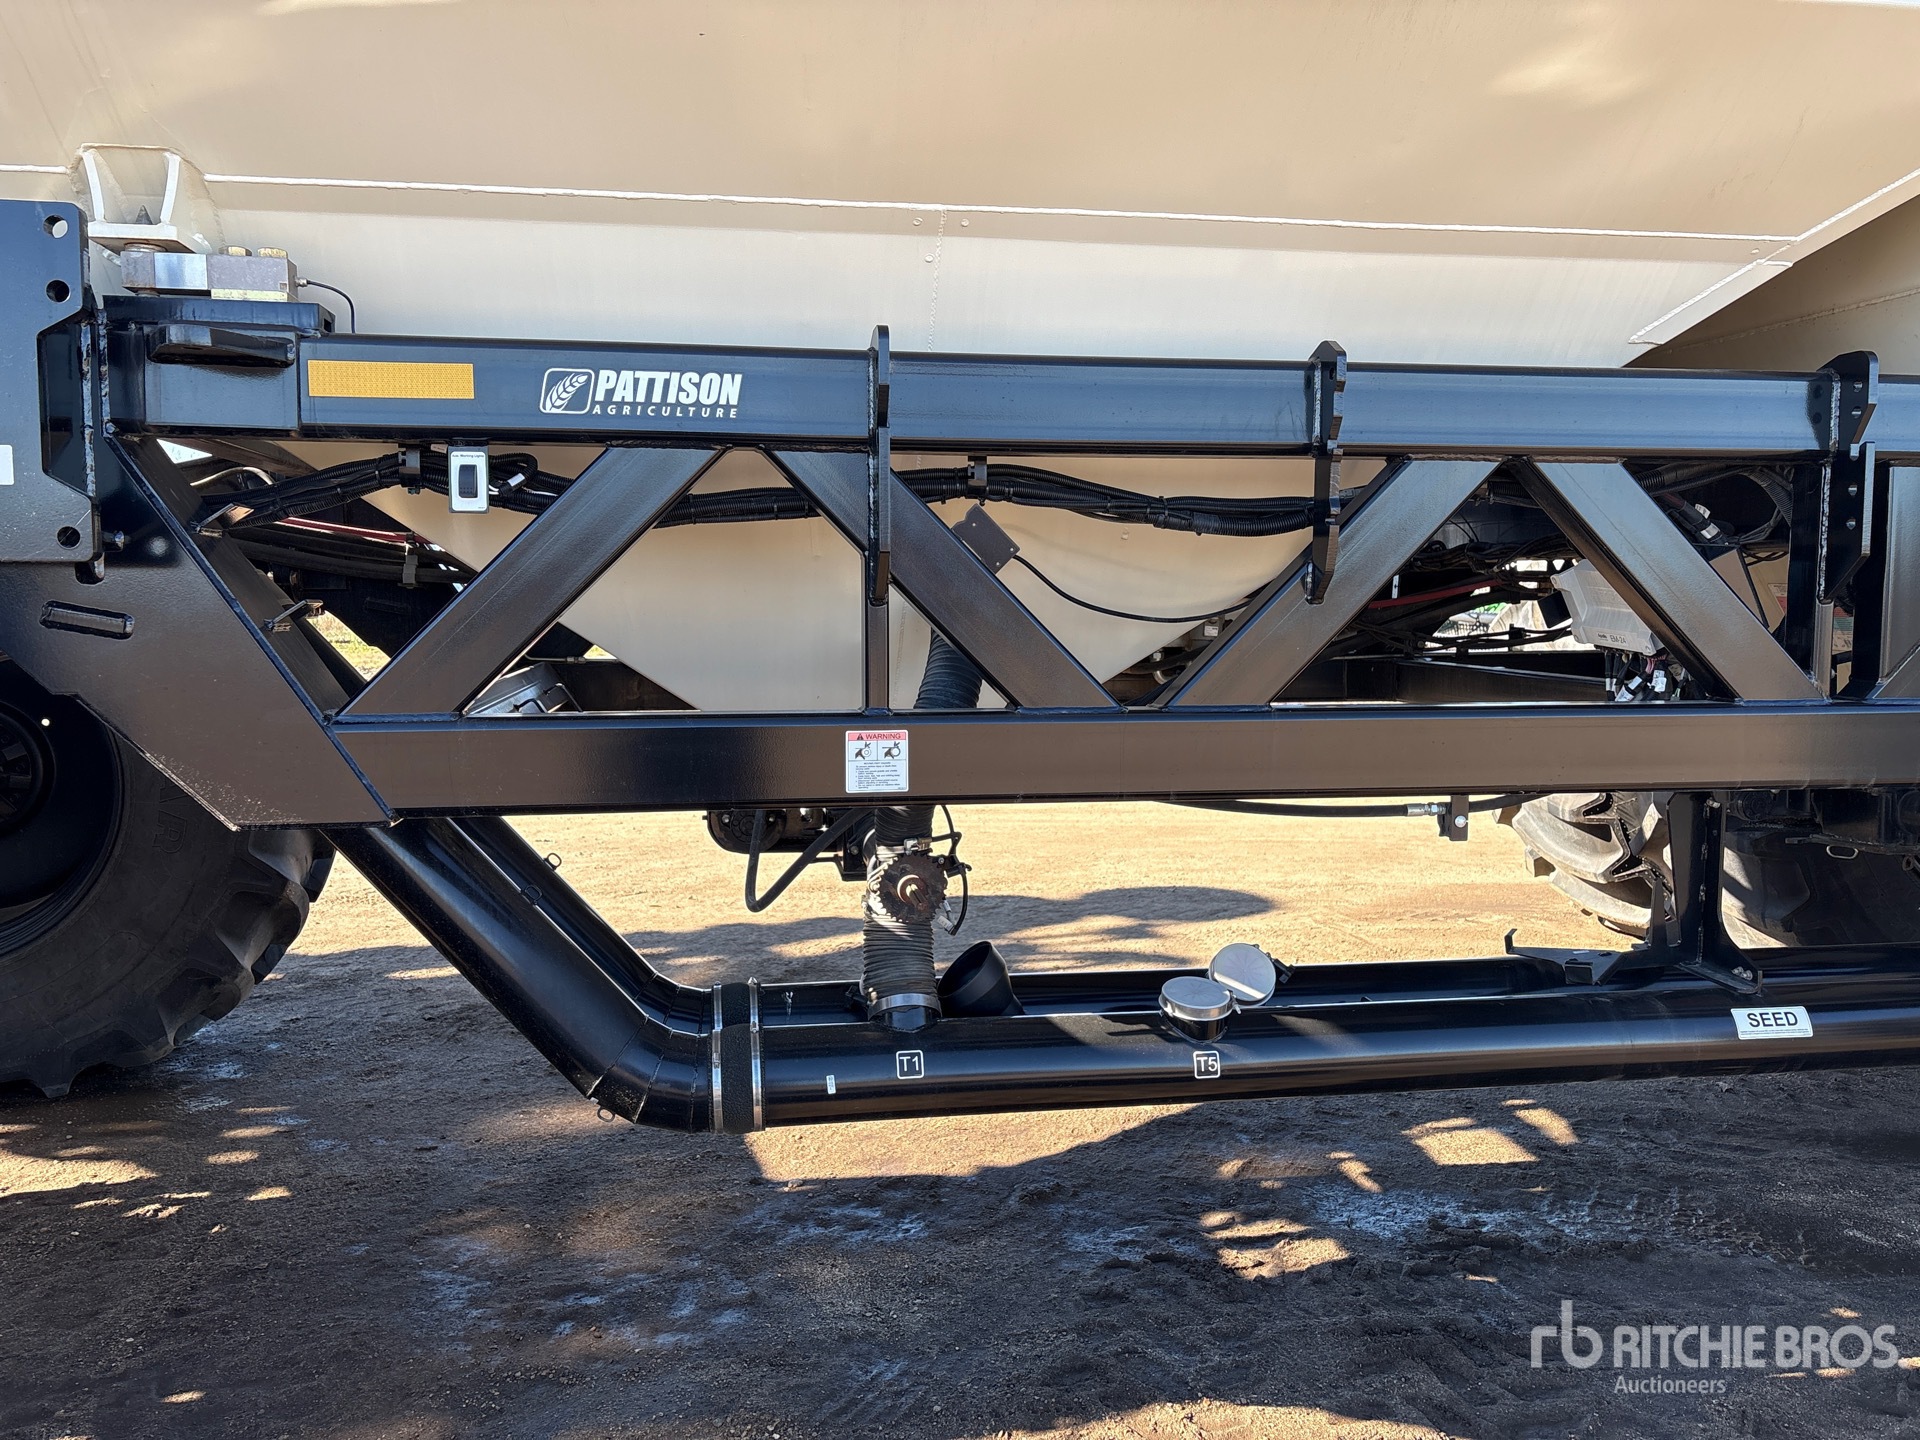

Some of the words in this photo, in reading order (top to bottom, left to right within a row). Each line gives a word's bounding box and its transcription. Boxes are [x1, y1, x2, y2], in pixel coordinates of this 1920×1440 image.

[595, 369, 742, 405] PATTISON
[592, 404, 738, 418] AGRICULTURE
[865, 732, 901, 740] WARNING
[1747, 1011, 1798, 1028] SEED
[899, 1055, 919, 1072] T1
[1196, 1056, 1217, 1072] T5
